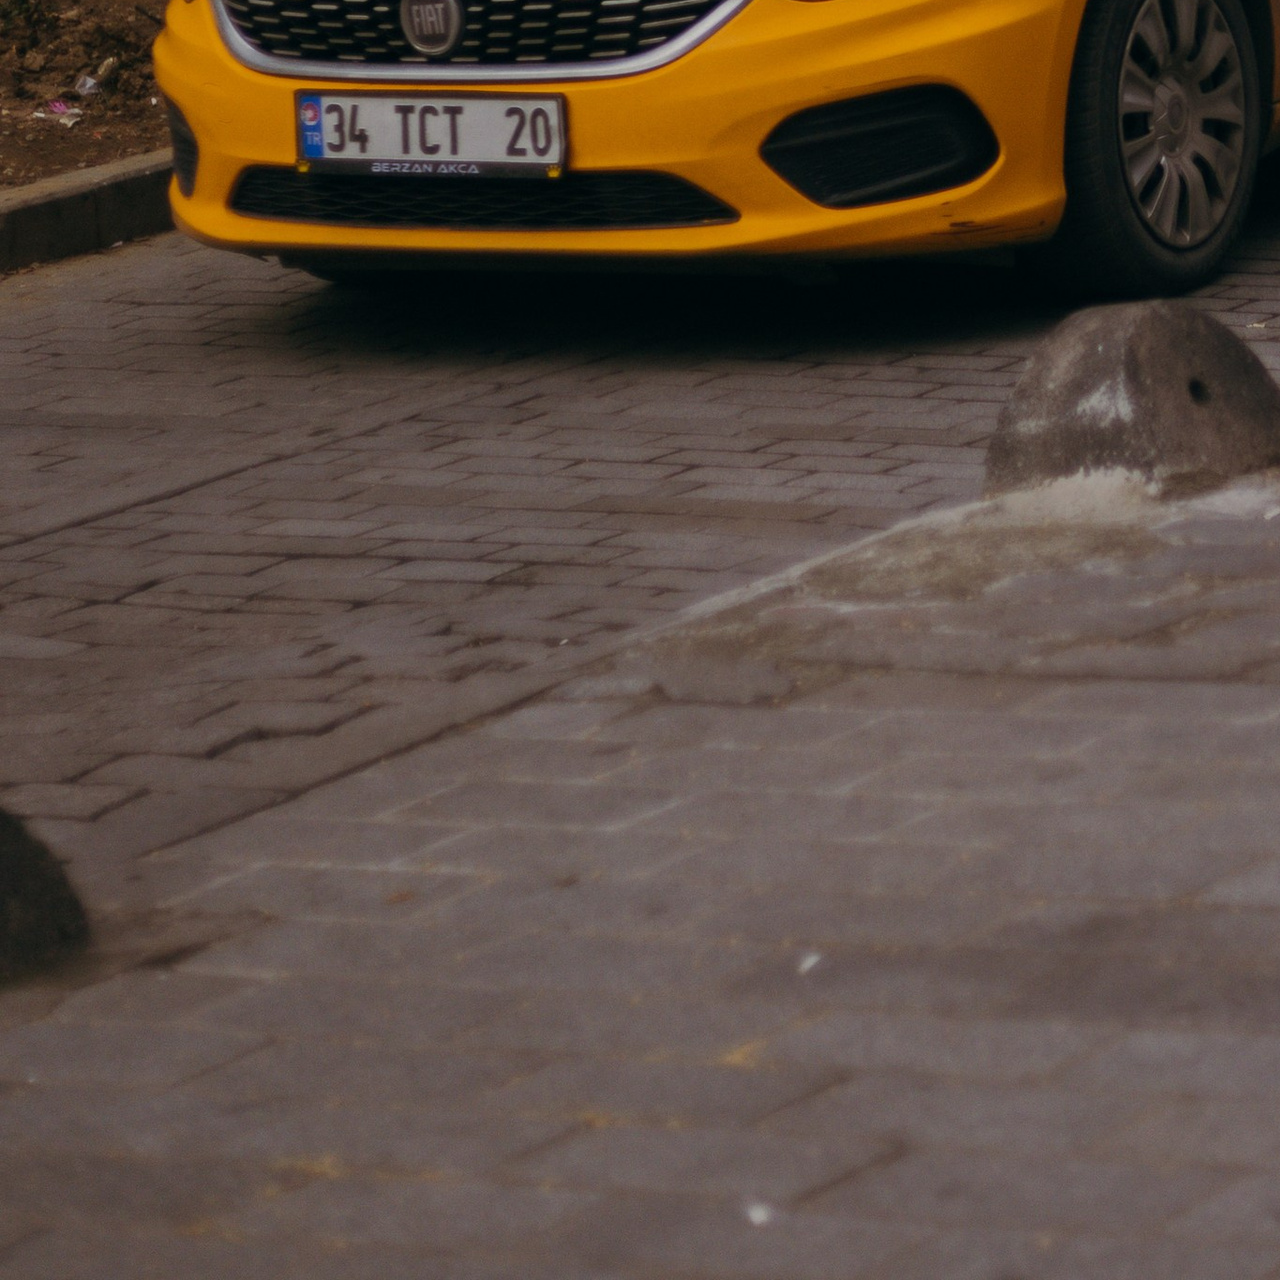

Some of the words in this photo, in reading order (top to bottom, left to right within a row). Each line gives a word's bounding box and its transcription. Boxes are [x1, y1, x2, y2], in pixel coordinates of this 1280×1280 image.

[411, 3, 444, 35] FIAT
[304, 131, 321, 146] TR
[325, 103, 369, 153] 34
[394, 104, 463, 156] TCT
[504, 106, 551, 157] 20
[371, 162, 433, 174] BERZAN
